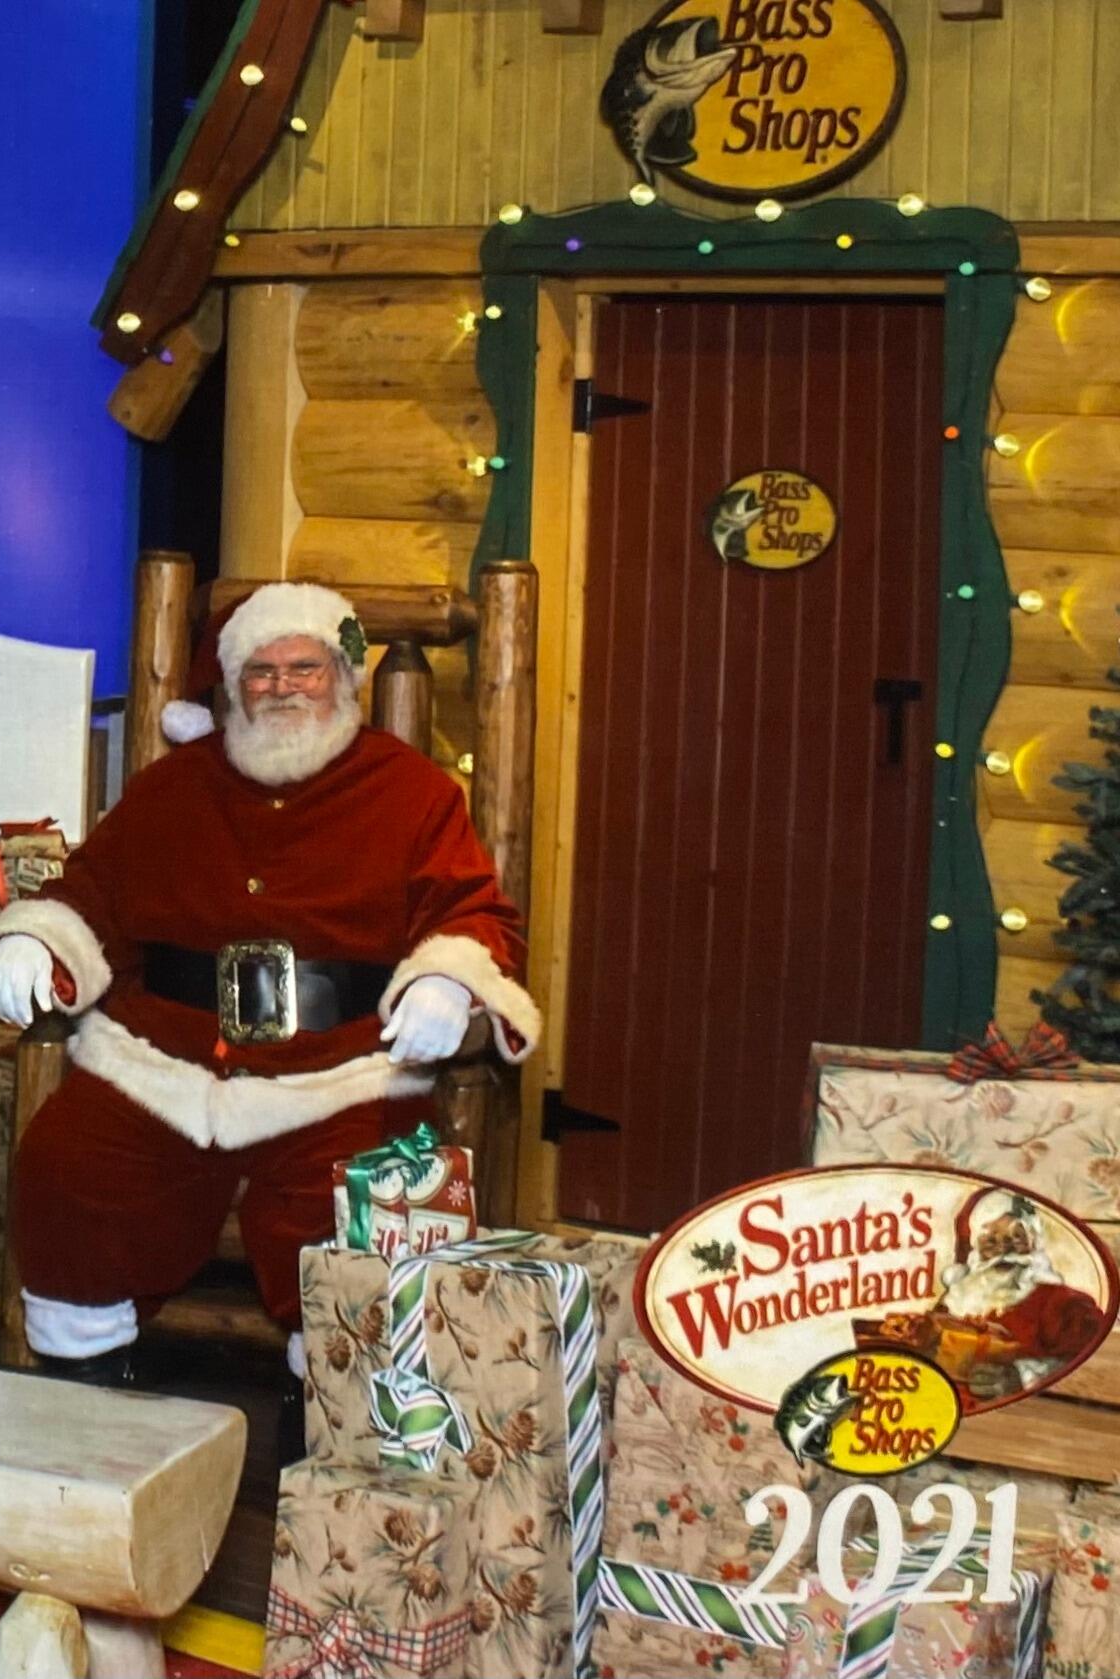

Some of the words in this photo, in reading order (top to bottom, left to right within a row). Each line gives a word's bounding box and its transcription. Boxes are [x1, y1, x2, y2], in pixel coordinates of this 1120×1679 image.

[721, 0, 833, 44] Bass
[723, 44, 808, 98] Pro
[722, 98, 862, 164] Shops
[758, 473, 811, 500] Bass
[760, 500, 799, 526] Pro
[758, 524, 823, 558] Shops
